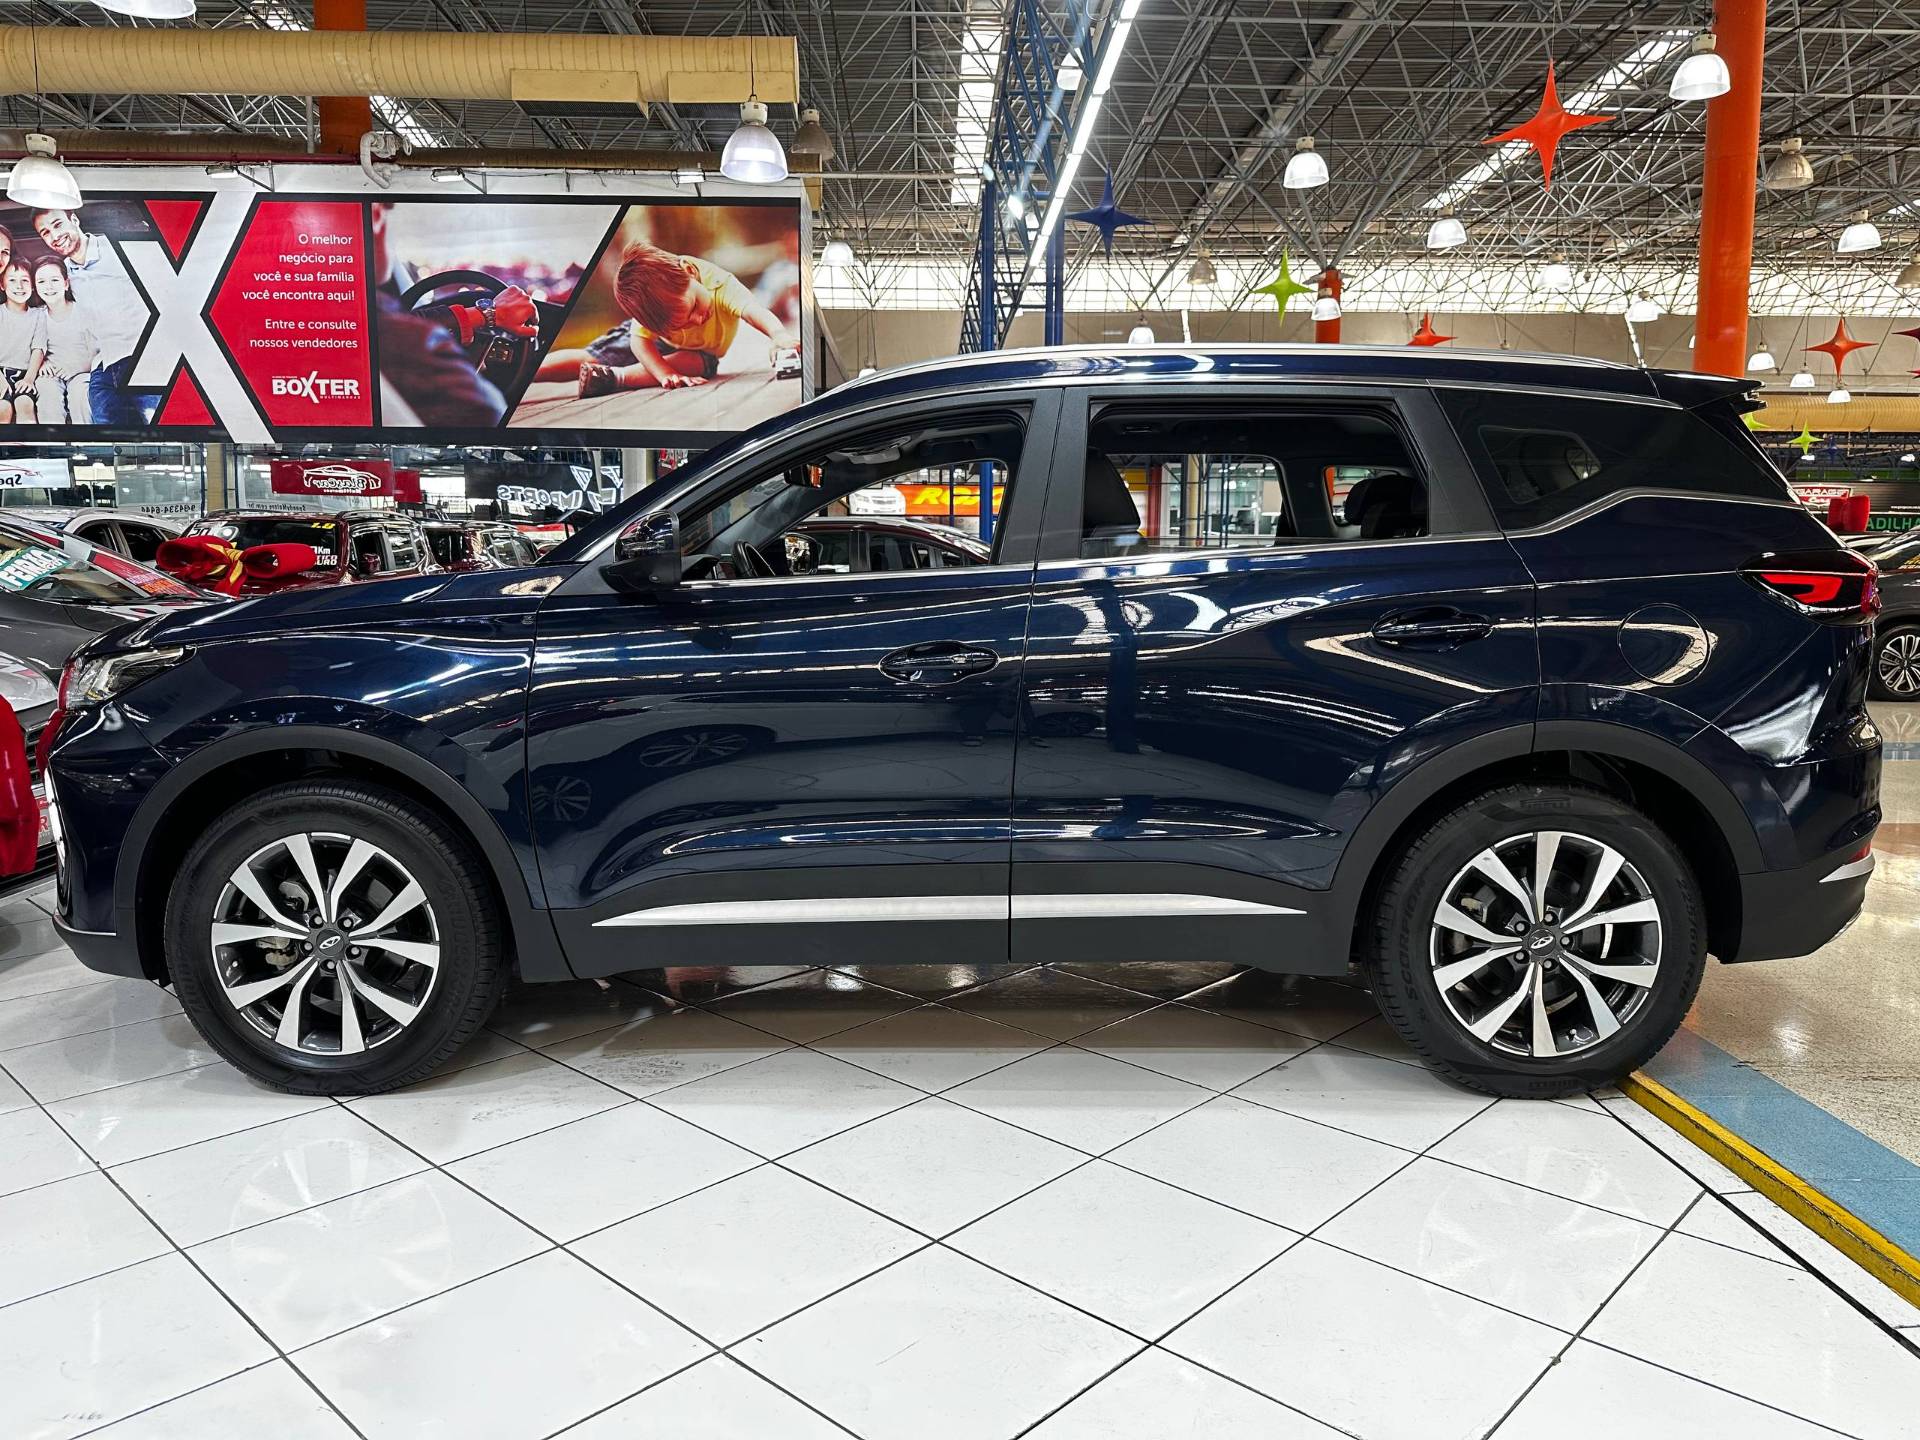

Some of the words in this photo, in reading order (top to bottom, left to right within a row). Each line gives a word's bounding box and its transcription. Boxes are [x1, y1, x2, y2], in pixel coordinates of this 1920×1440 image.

[298, 233, 309, 245] O
[312, 234, 353, 245] melhor
[279, 253, 326, 265] negócio
[328, 254, 354, 266] para
[253, 271, 282, 282] você
[284, 273, 292, 282] e
[294, 273, 314, 282] sua
[316, 271, 355, 282] família
[242, 290, 270, 300] você
[272, 290, 324, 301] encontra
[327, 290, 355, 303] aqui!
[265, 318, 295, 329] Entre
[297, 321, 305, 329] e
[307, 319, 357, 330] consulte
[249, 339, 289, 348] nossos
[291, 338, 358, 348] vendedores
[271, 370, 361, 404] BOXTER
